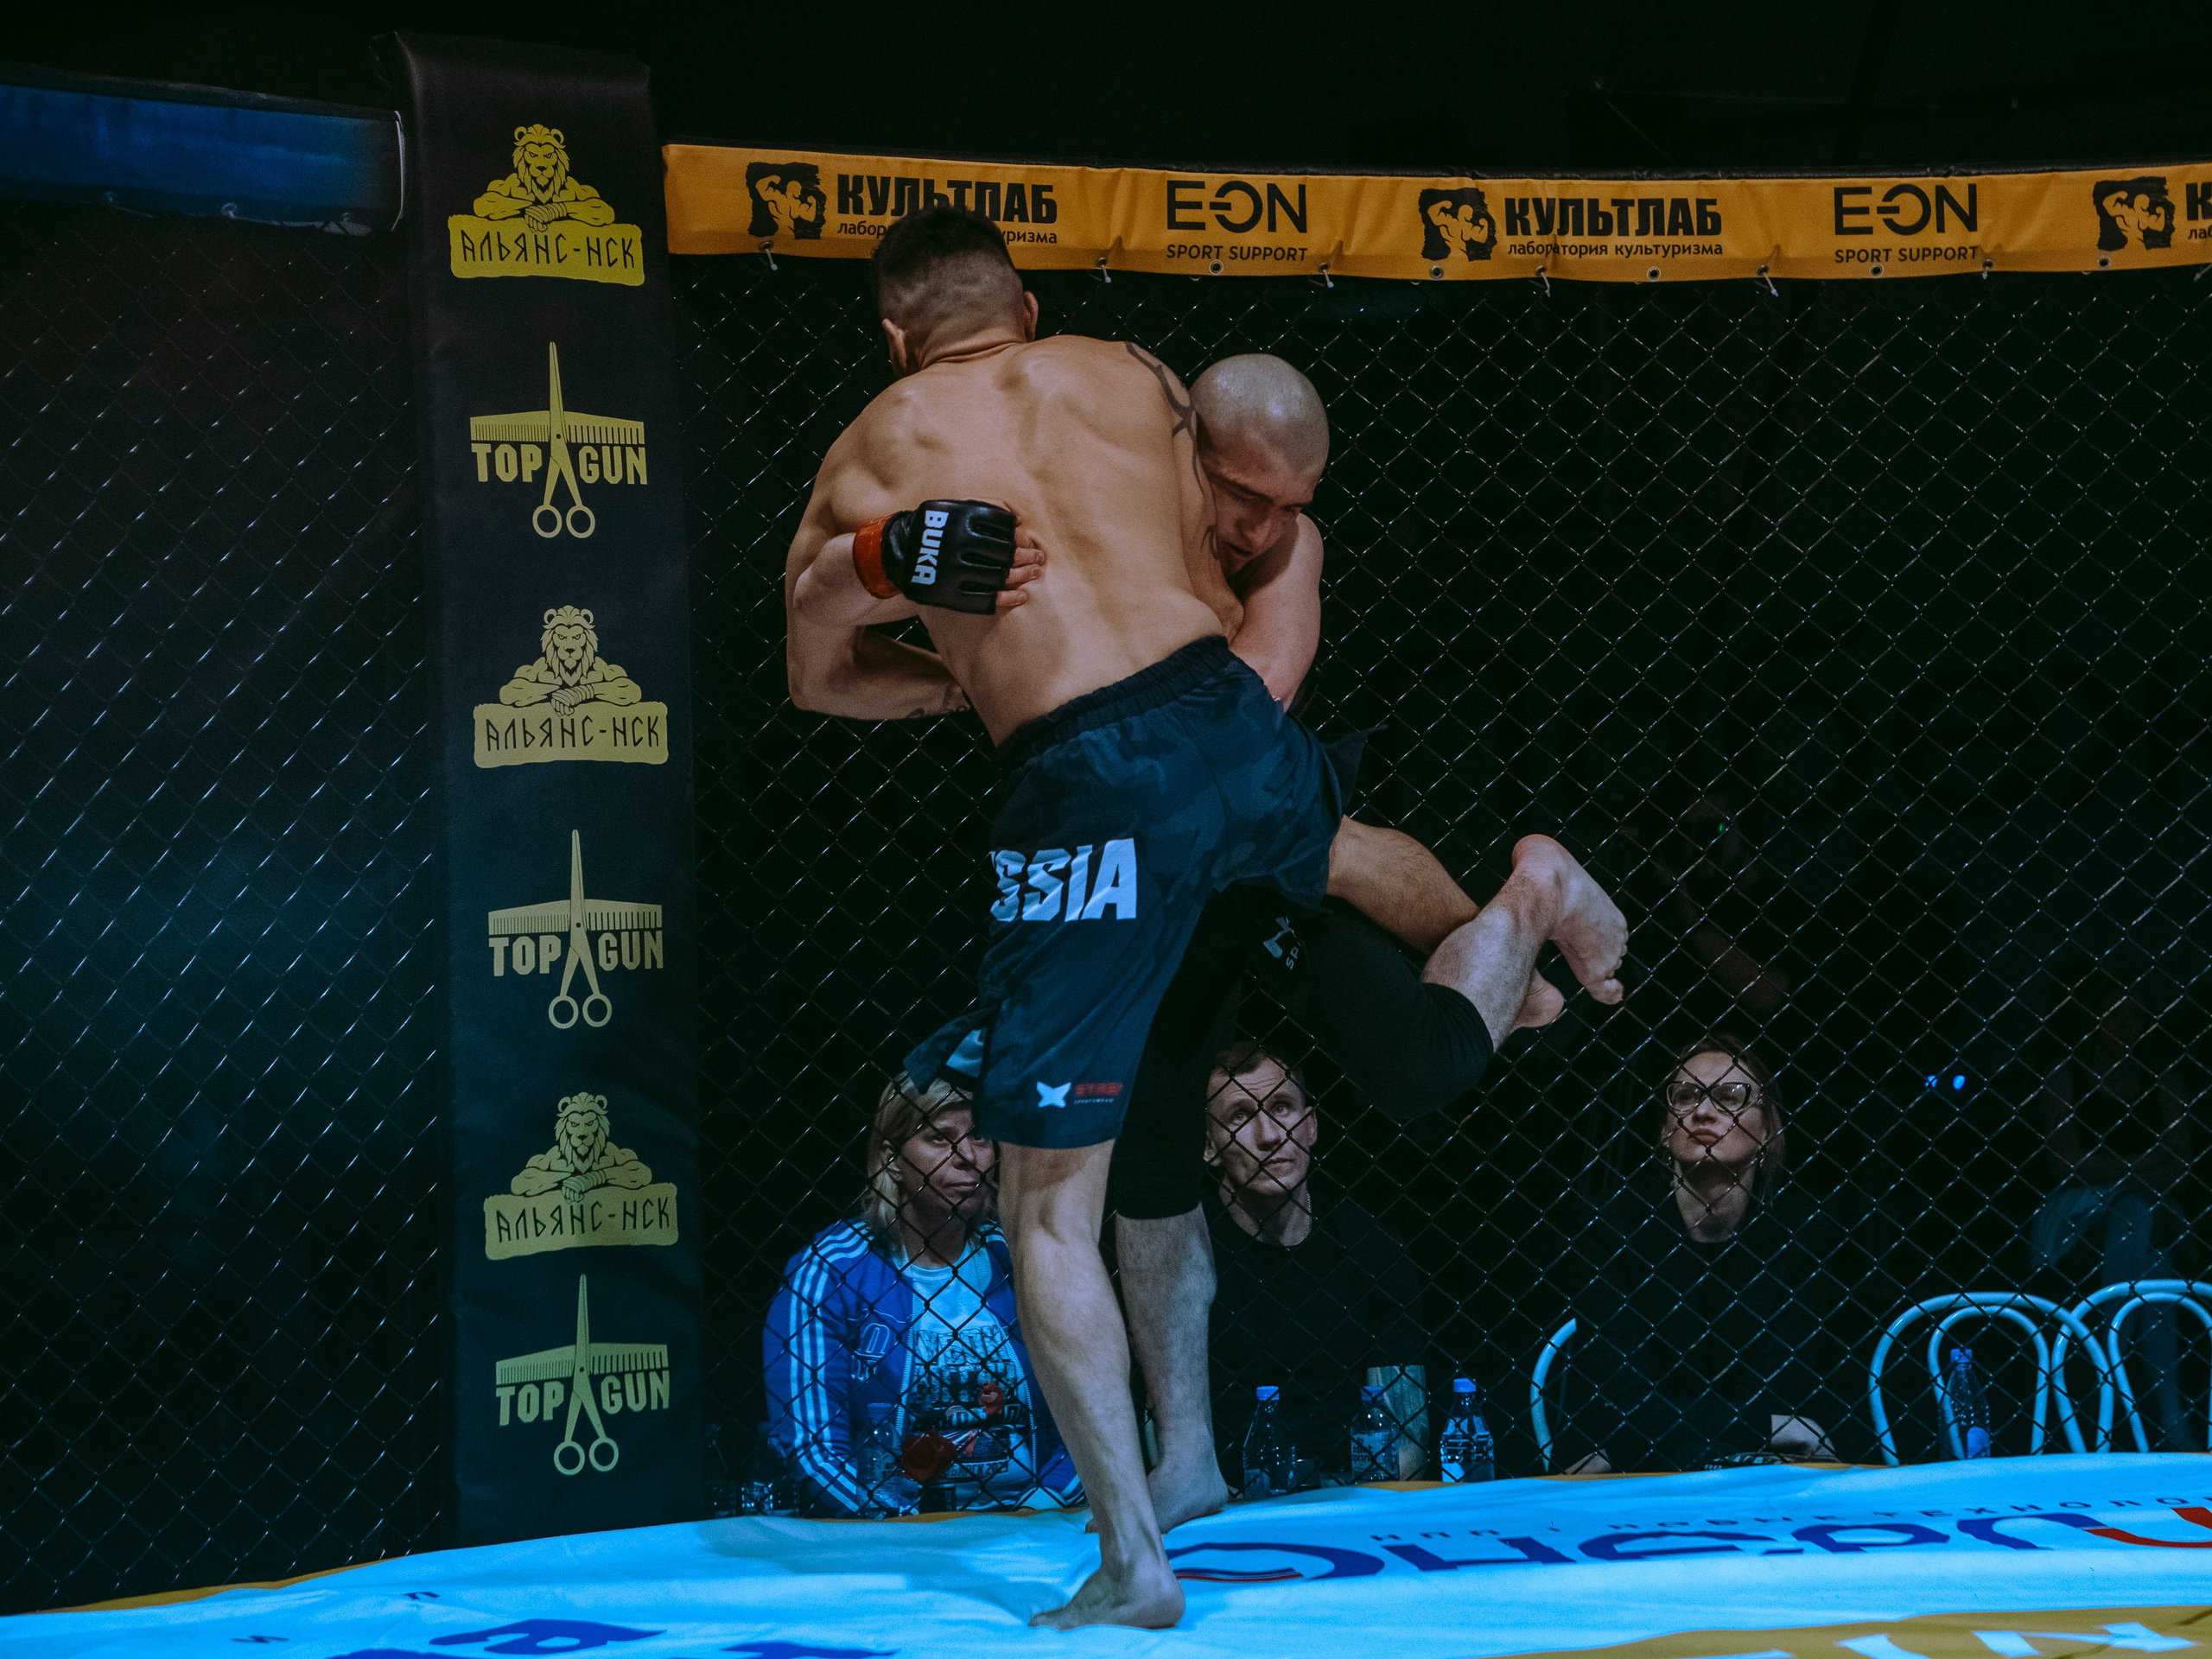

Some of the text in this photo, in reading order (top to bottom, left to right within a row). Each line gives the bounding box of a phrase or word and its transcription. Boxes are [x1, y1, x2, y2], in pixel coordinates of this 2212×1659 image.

[837, 220, 1058, 245] лабор ризма
[1503, 197, 1723, 237] КУЛЬТЛАБ
[460, 228, 637, 270] АЛЬЯНС-НСК
[1166, 244, 1308, 262] SPORT SUPPORT
[1507, 240, 1724, 258] лаборатория культуризма
[1834, 245, 1980, 264] SPORT SUPPORT
[471, 442, 648, 486] TOP GUN
[911, 510, 950, 585] BUKA
[485, 714, 660, 752] АЛЬЯНС-НСК
[991, 837, 1137, 922] SSIA
[488, 930, 664, 977] TOP GUN
[496, 1196, 671, 1243] АЛЬЯНС-НСК
[495, 1370, 671, 1427] TOP GUN
[1871, 1495, 2212, 1518] ТЕХНОЛО
